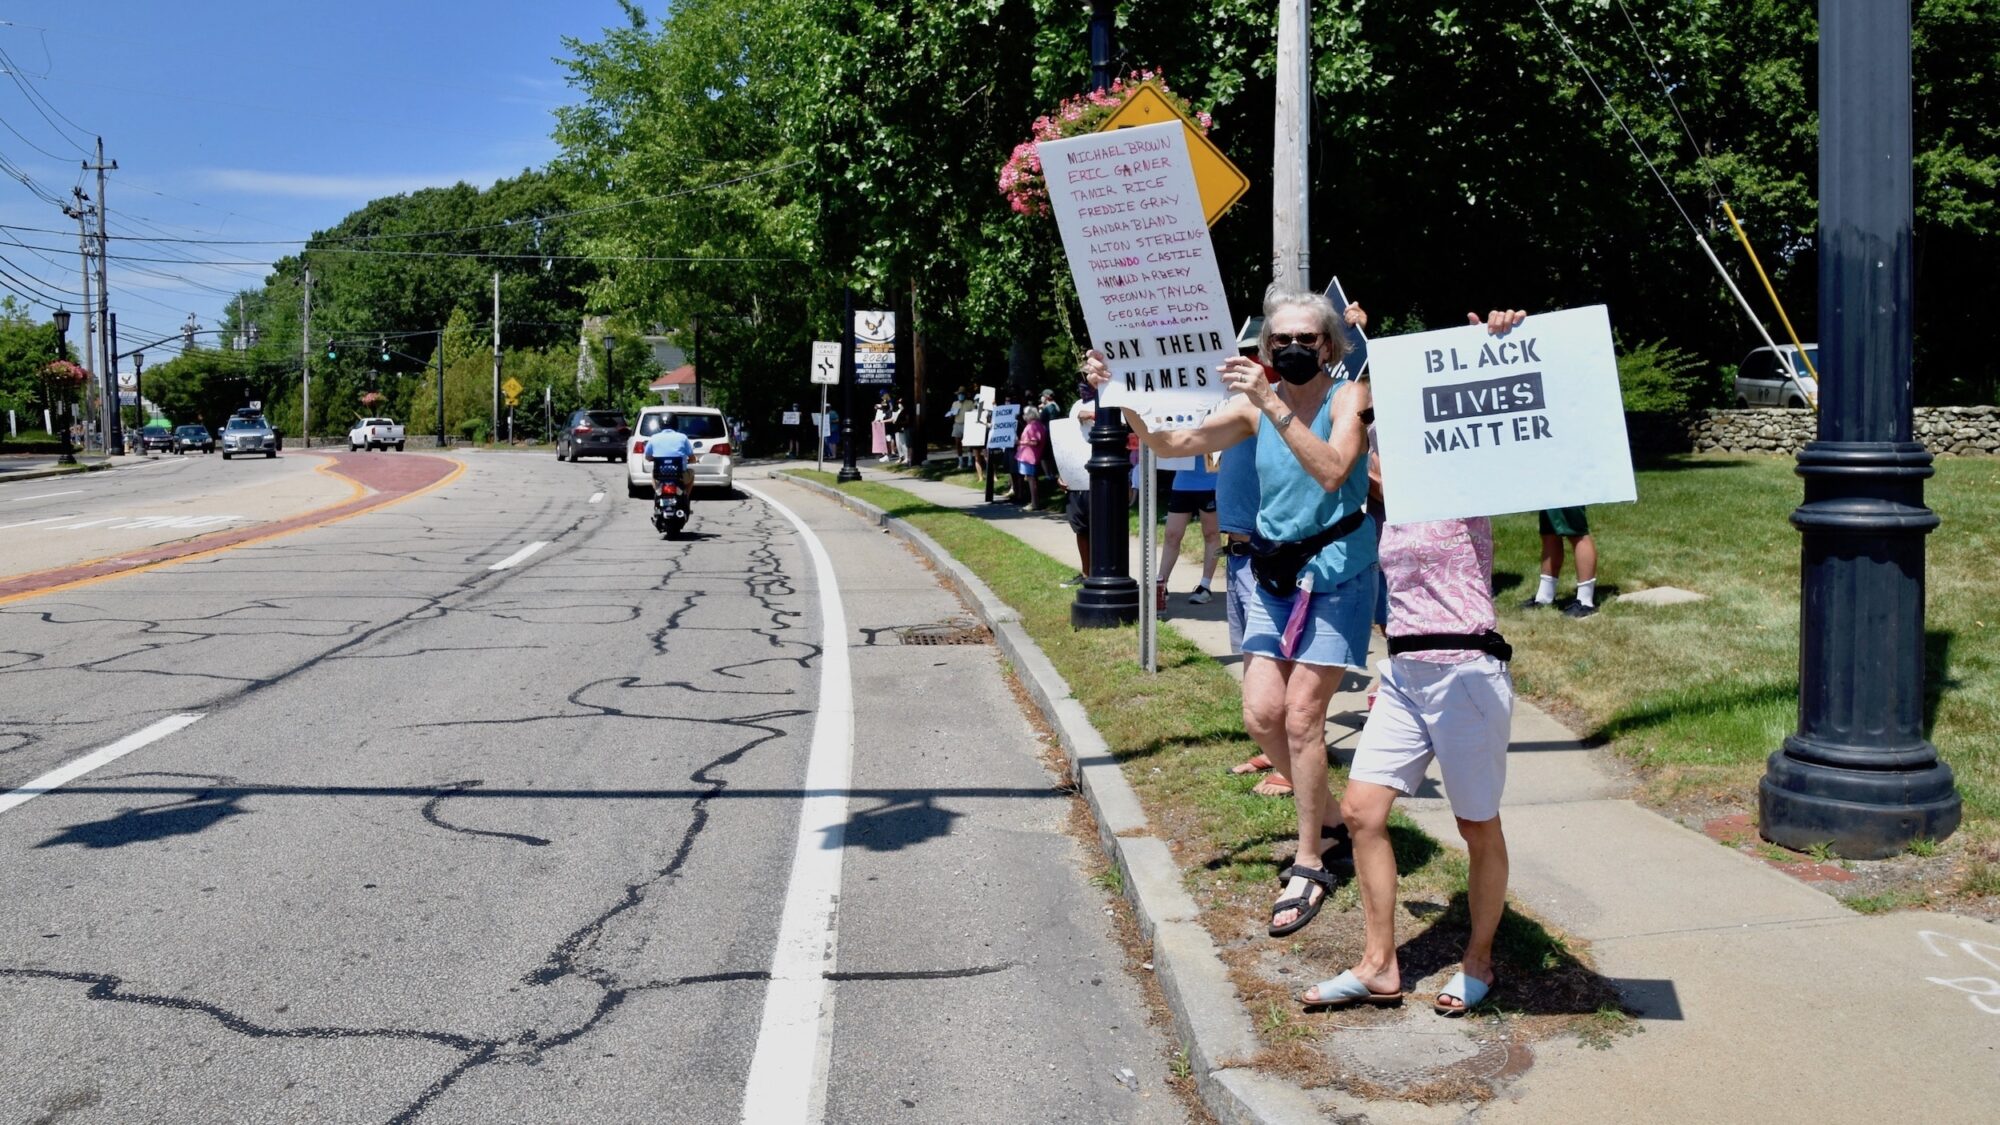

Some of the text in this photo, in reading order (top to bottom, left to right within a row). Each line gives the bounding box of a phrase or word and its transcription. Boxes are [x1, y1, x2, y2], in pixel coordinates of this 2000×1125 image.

[1067, 136, 1171, 165] MICHAEL BROWN
[1068, 157, 1172, 184] ERIC GARNER
[1070, 176, 1167, 201] TAMIR RICE
[1078, 194, 1179, 219] FREDDIE GRAY
[1082, 214, 1178, 238] SANDRA BLAND
[1090, 228, 1204, 255] ALTON STERLING
[1088, 248, 1202, 272] PHILANDO CASTILE
[1097, 267, 1191, 289] AHMAUD ARBERY
[1100, 284, 1208, 305] BREONNA TAYLOR
[1108, 302, 1209, 321] GEORGE FLOYD
[862, 353, 889, 363] 2020
[1104, 331, 1222, 360] SAY THEIR
[1425, 337, 1542, 373] BLACK
[1126, 367, 1207, 392] NAMES
[1431, 382, 1534, 417] LIVES
[1424, 415, 1553, 454] MATTER
